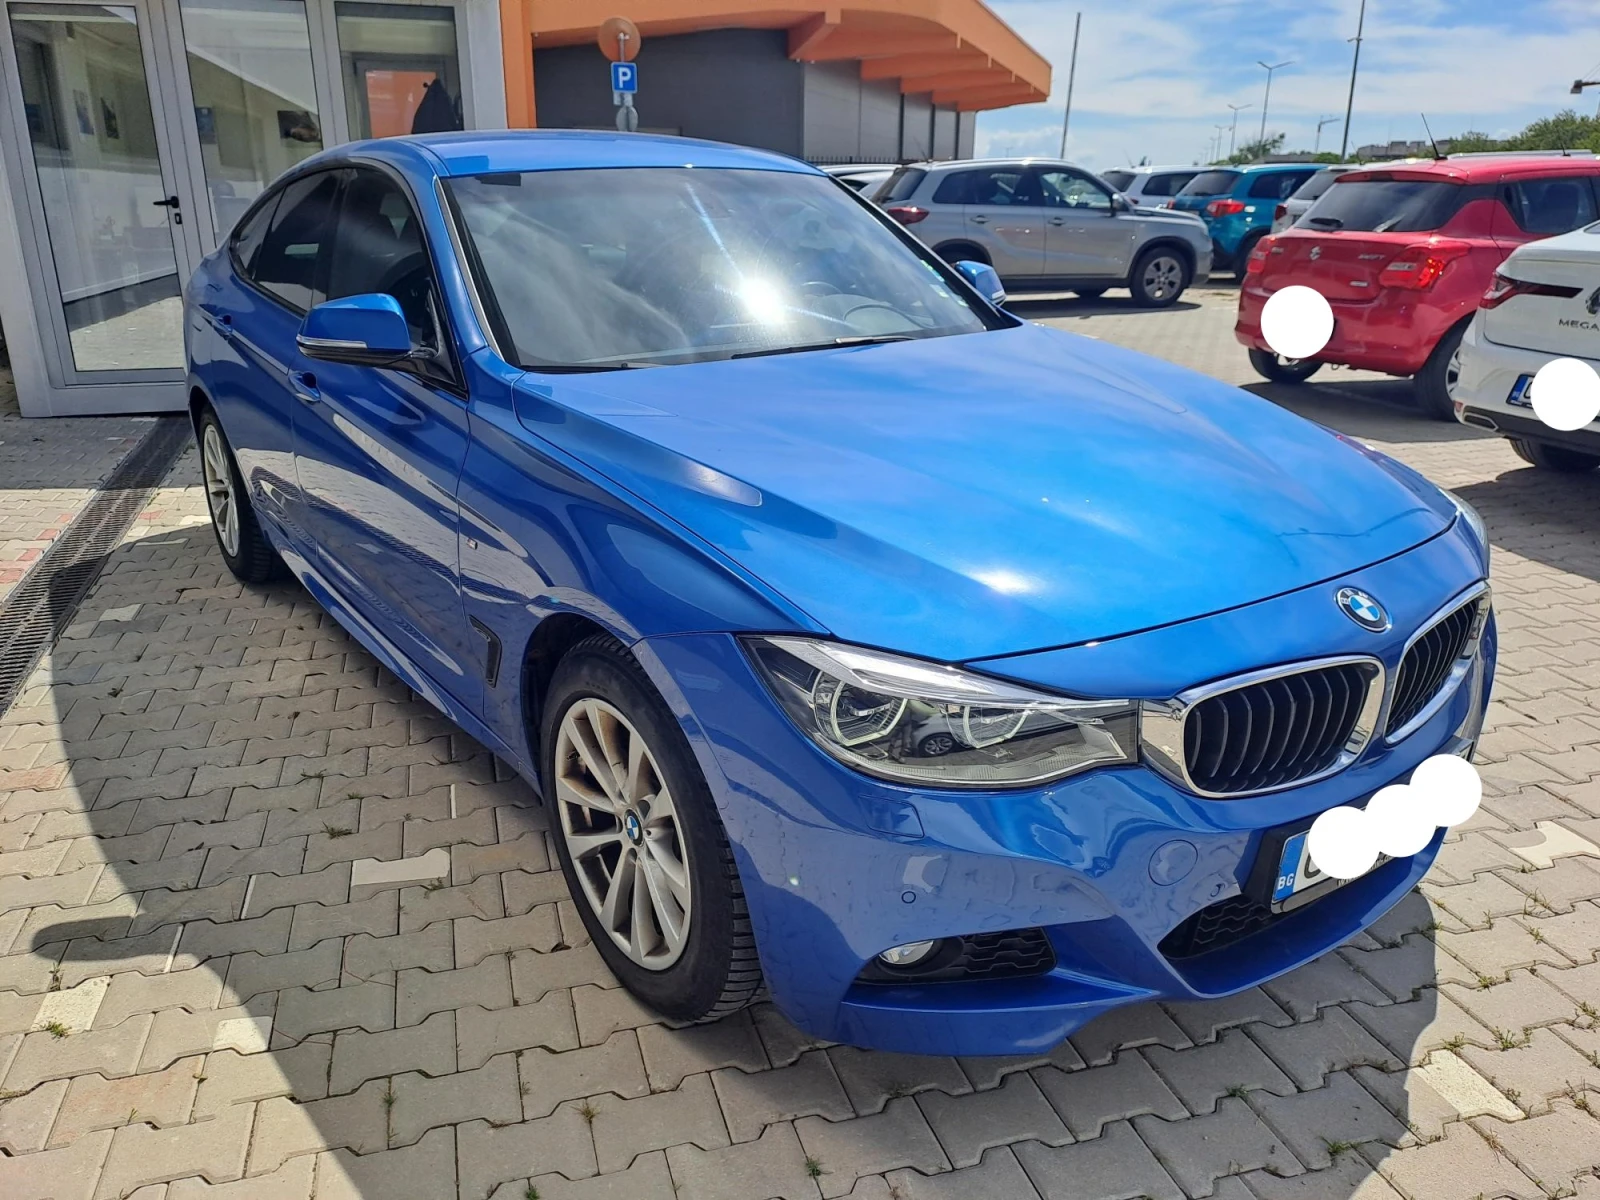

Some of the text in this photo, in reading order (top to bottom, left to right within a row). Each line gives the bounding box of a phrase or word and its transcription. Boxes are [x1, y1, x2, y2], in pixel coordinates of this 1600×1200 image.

[618, 67, 631, 89] P
[1558, 318, 1600, 331] MEGA
[1277, 873, 1295, 891] BG
